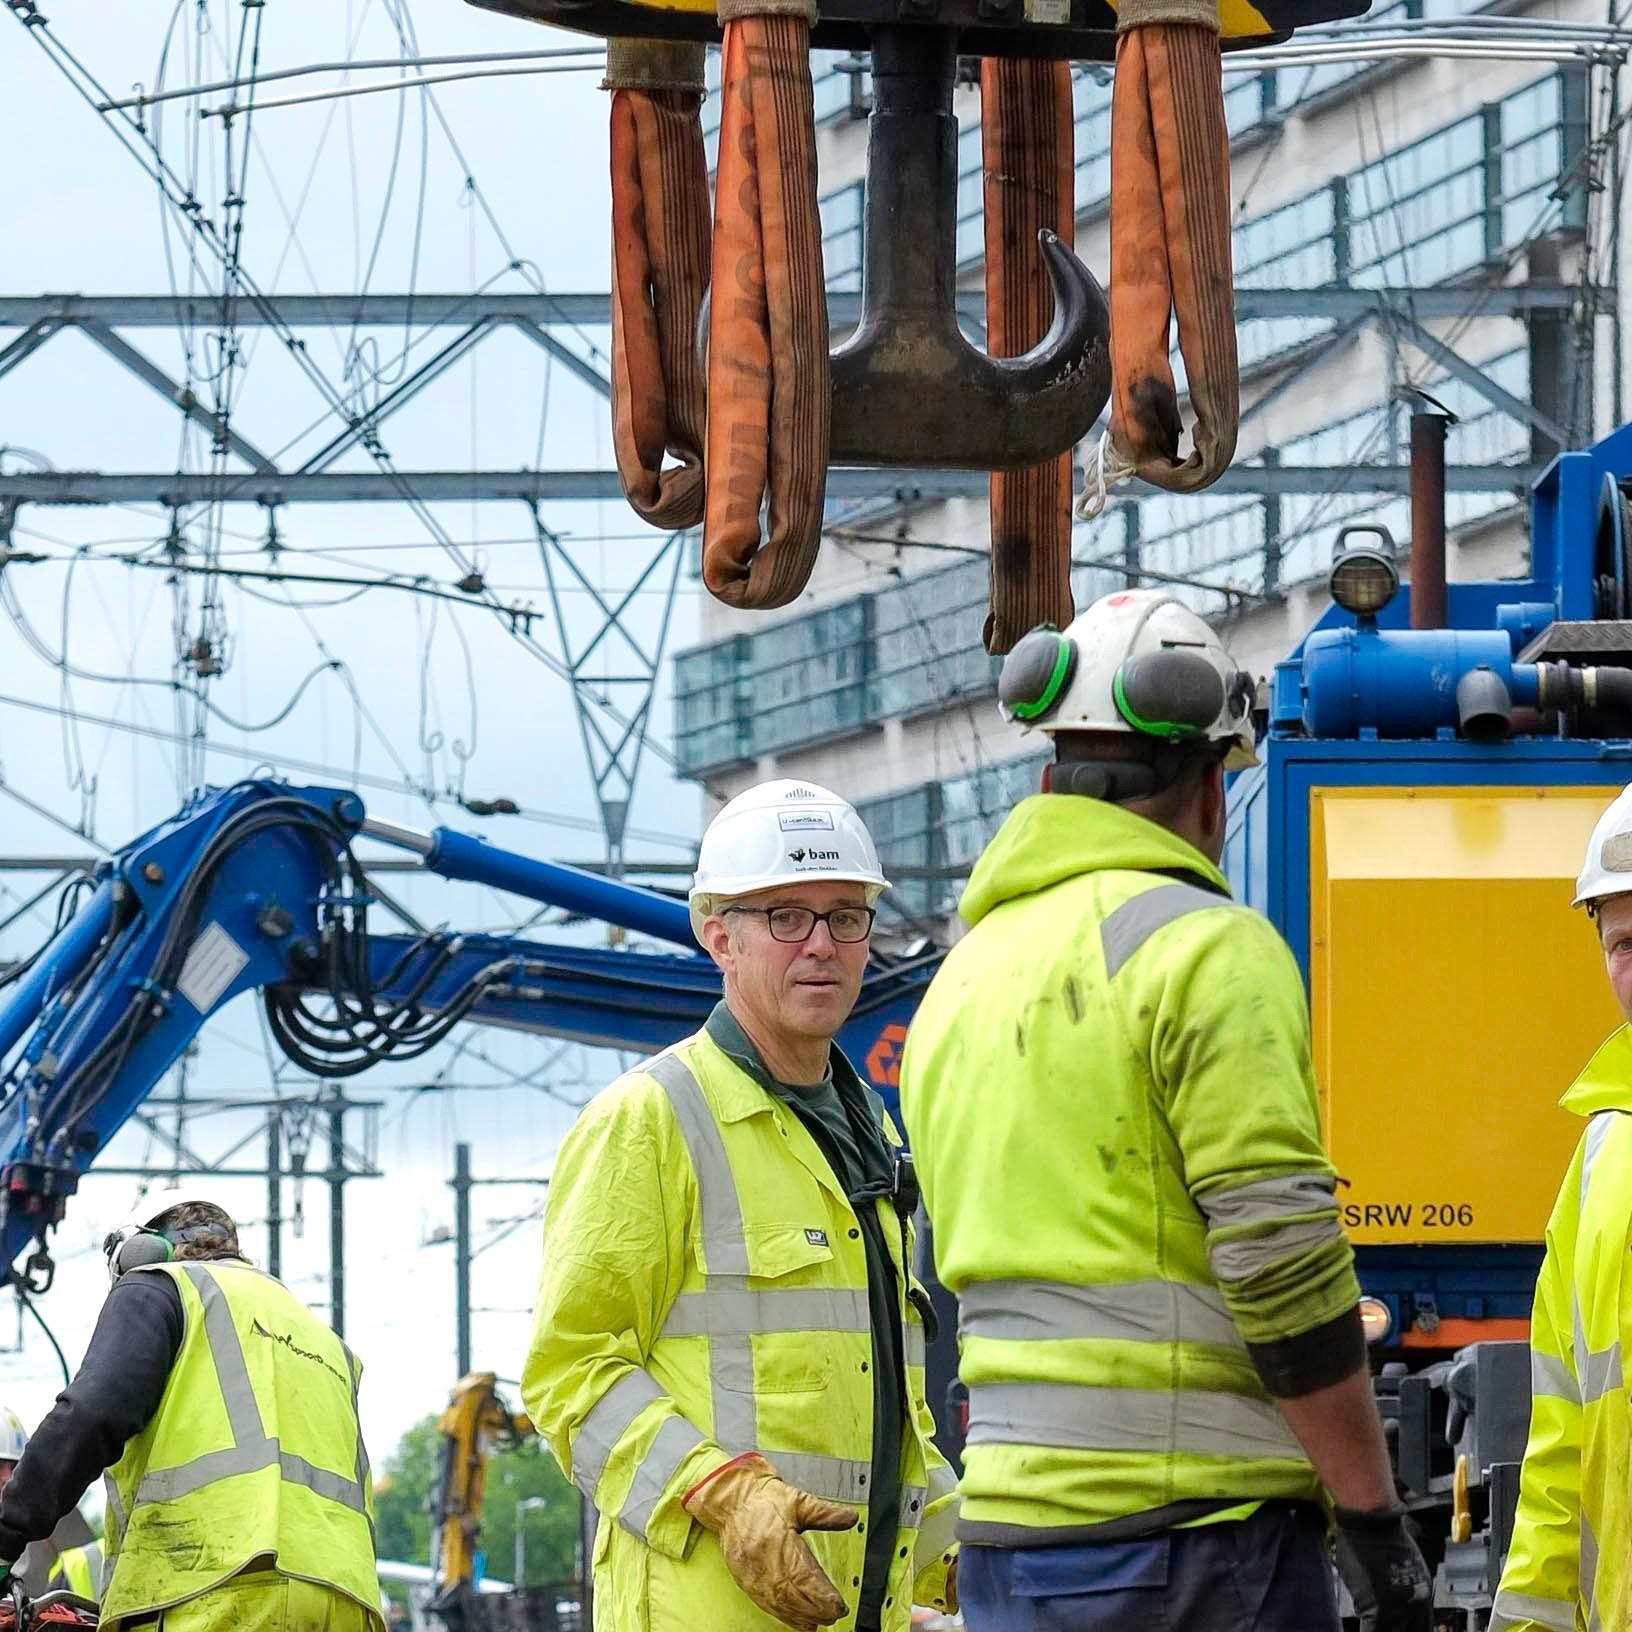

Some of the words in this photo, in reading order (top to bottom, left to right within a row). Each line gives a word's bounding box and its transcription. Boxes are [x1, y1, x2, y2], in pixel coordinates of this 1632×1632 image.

[809, 848, 840, 860] bam
[1344, 1204, 1412, 1227] SRW
[1422, 1204, 1473, 1227] 206
